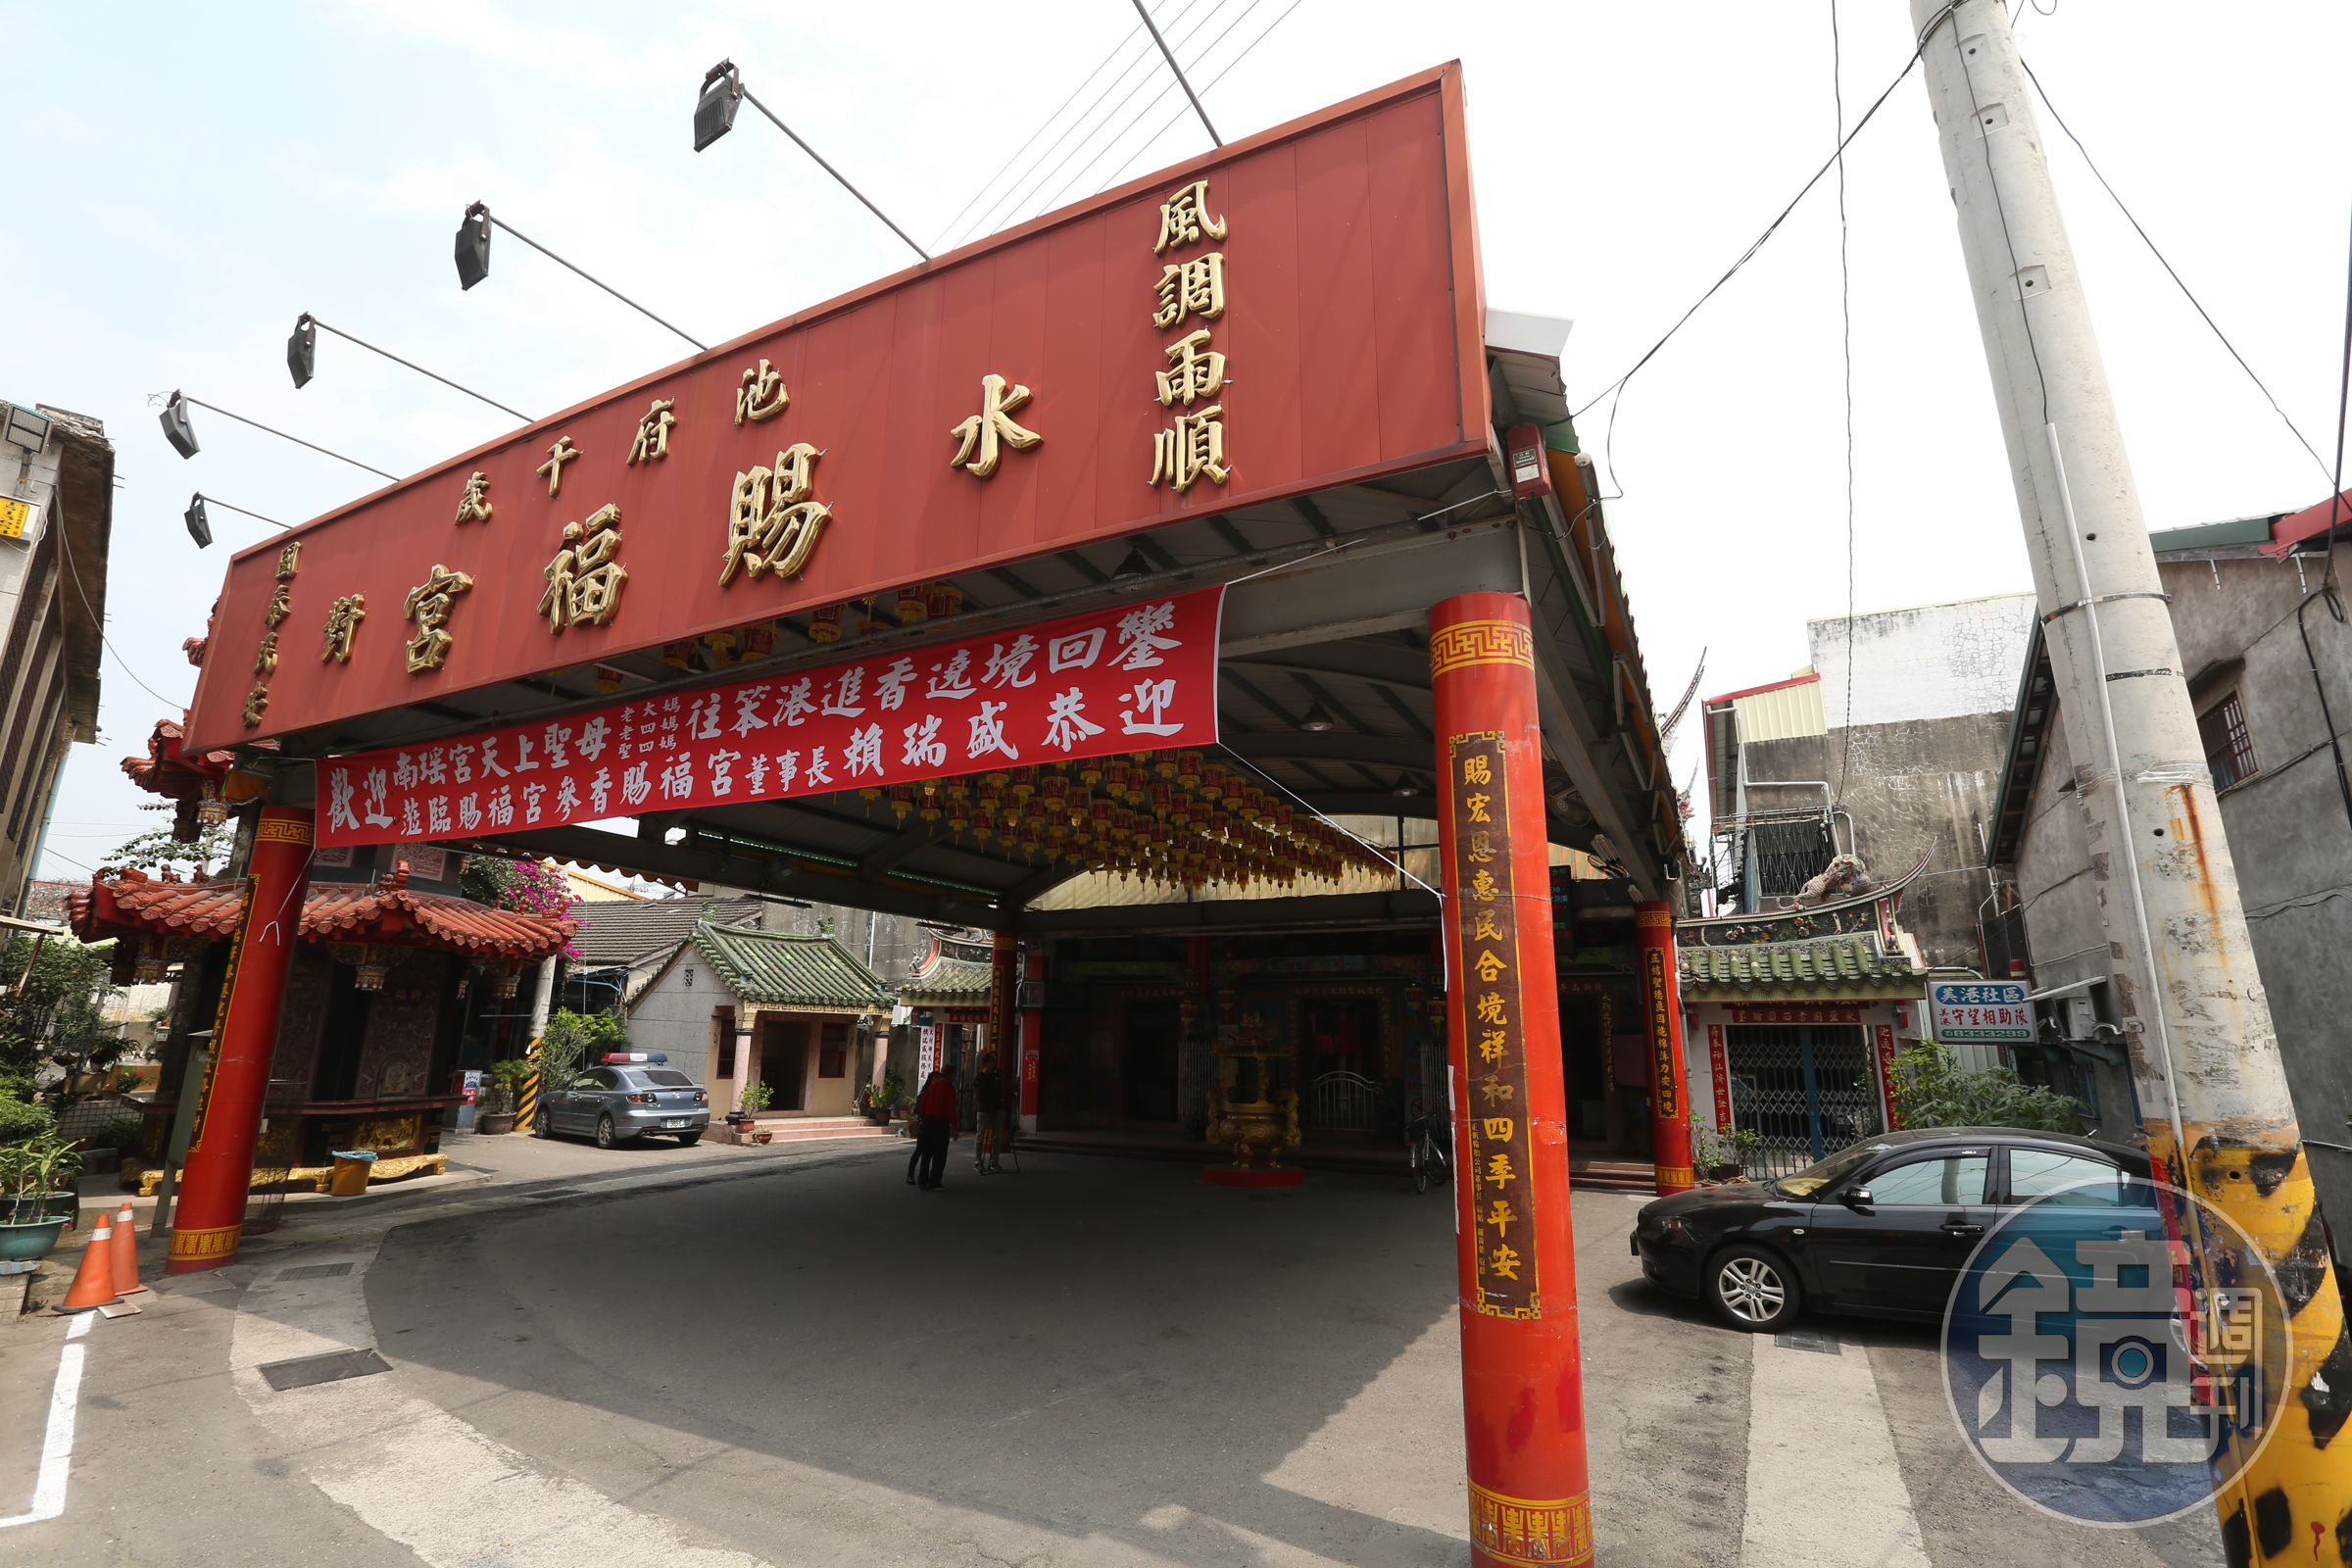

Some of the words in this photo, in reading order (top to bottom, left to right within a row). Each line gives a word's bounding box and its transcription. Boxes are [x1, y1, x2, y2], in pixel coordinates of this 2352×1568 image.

[1150, 177, 1231, 495] 風調雨順
[454, 358, 789, 525] 池府千歲
[241, 541, 302, 728] 國泰民安
[1464, 755, 1521, 1281] 賜宏恩惠民合境祥和四季平安
[1940, 987, 2021, 1003] 美港社區
[1952, 1007, 2029, 1026] 守望相助隊
